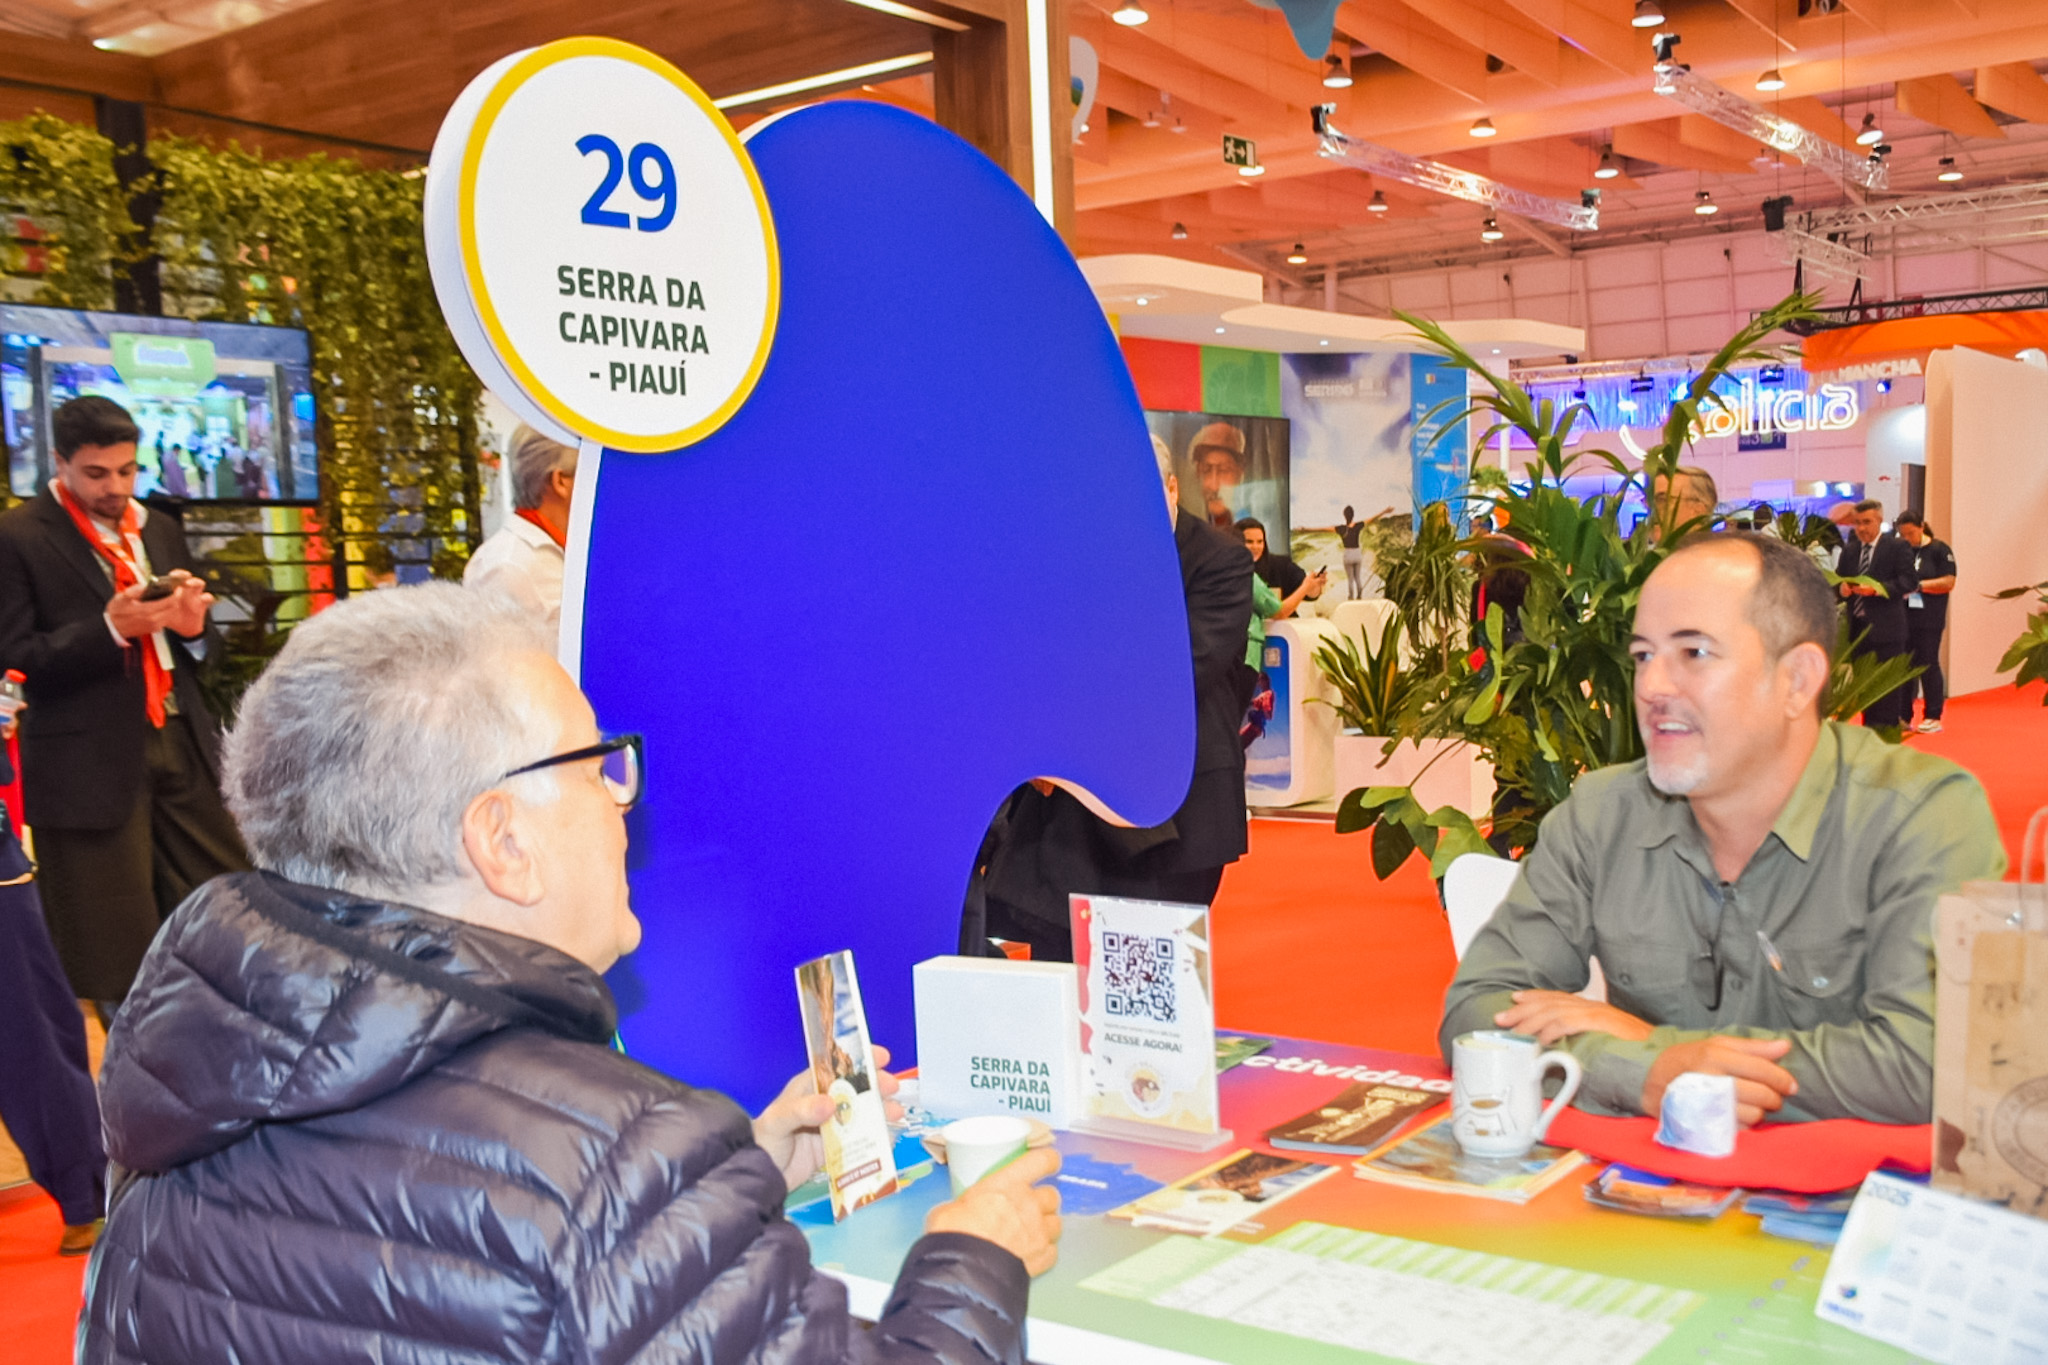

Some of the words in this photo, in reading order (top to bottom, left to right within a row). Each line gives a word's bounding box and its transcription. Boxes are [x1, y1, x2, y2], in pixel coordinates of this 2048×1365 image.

[574, 133, 678, 233] 29
[557, 264, 658, 306] SERRA
[665, 277, 706, 311] DA
[558, 311, 710, 354] CAPIVARA
[609, 359, 687, 396] PIAUÍ
[1838, 357, 1922, 383] MANCHA
[1104, 1032, 1141, 1047] ACESSE
[1142, 1038, 1183, 1053] AGORA!
[970, 1056, 1023, 1075] SERRA
[1027, 1060, 1050, 1077] DA
[970, 1074, 1051, 1095] CAPIVARA
